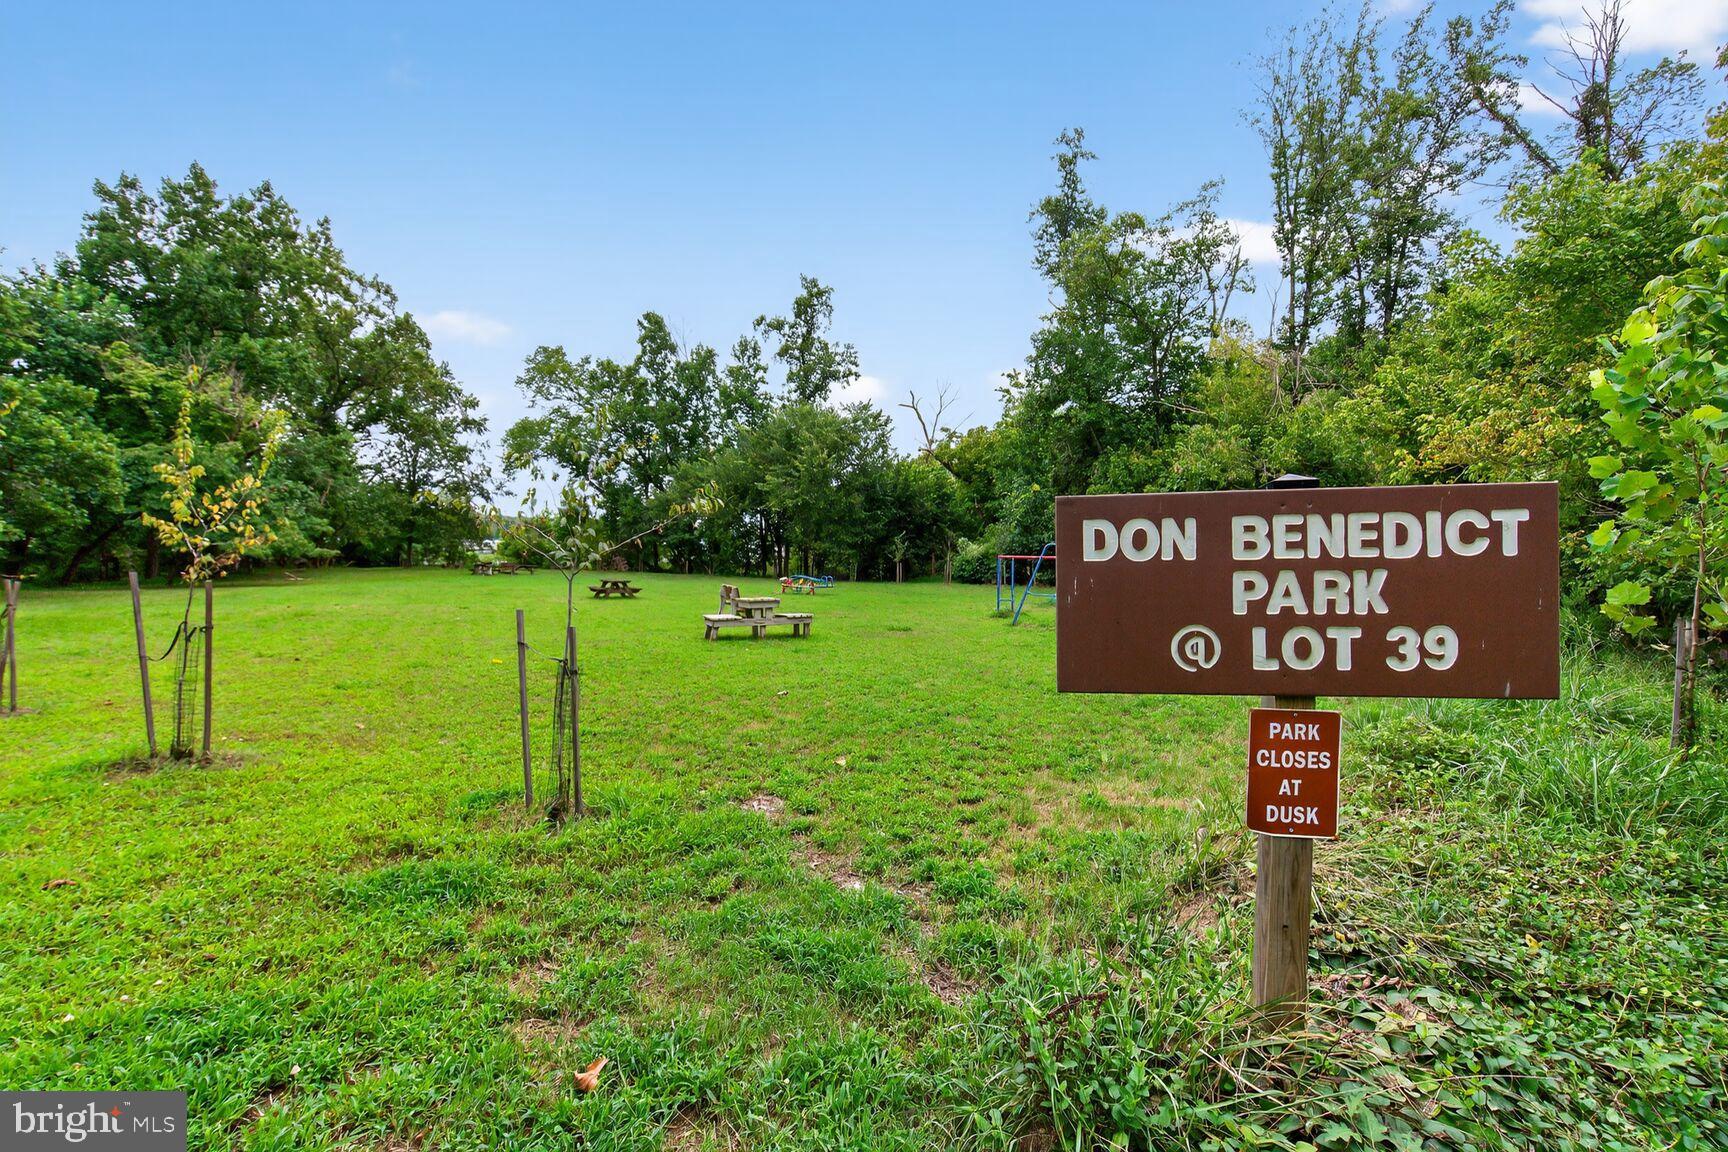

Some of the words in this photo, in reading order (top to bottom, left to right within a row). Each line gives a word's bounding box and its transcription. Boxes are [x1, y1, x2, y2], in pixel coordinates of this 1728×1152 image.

[1082, 517, 1198, 562] DON
[1231, 508, 1531, 561] BENEDICT
[1232, 568, 1390, 616] PARK
[1170, 624, 1222, 673] @
[1252, 626, 1363, 672] LOT
[1385, 624, 1459, 672] 39
[1269, 722, 1321, 741] PARK
[1256, 749, 1331, 769] CLOSES
[1278, 778, 1302, 796] AT
[1266, 804, 1319, 825] DUSK
